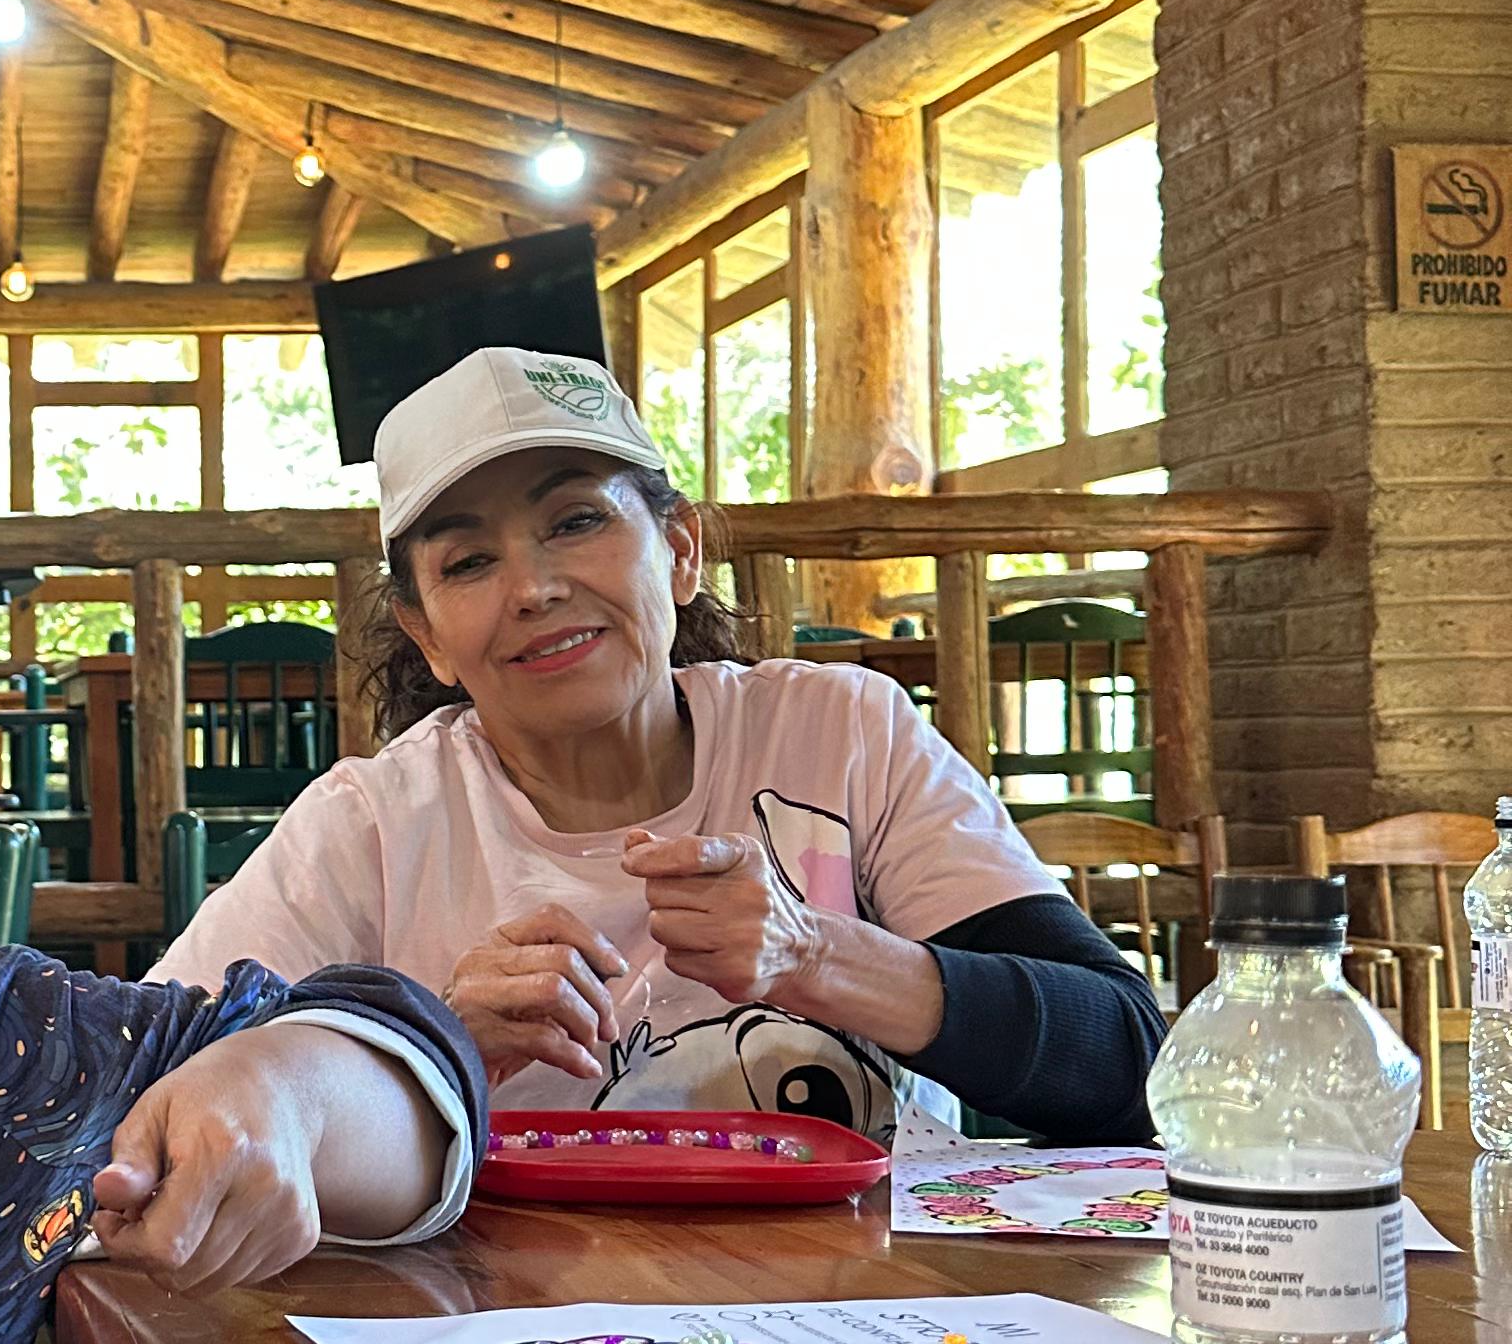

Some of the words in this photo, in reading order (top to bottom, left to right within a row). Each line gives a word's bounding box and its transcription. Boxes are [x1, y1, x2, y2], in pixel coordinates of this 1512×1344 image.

[1411, 252, 1508, 277] PROHIBIDO
[1419, 281, 1502, 306] FUMAR
[1207, 1213, 1245, 1227] TOYOTA
[1247, 1217, 1318, 1231] ACUEDUCTO
[1194, 1223, 1236, 1239] Acueducto
[1246, 1229, 1293, 1243] Periférico
[1195, 1237, 1207, 1248] Tel.
[1209, 1241, 1220, 1251] 33
[1209, 1265, 1247, 1279] TOYOTA
[1249, 1270, 1304, 1284] COUNTRY
[1210, 1293, 1220, 1304] 33
[1306, 1286, 1327, 1297] Plan
[1329, 1286, 1341, 1297] de
[1343, 1284, 1360, 1296] San
[1362, 1283, 1377, 1295] Luis
[975, 1321, 1041, 1338] MI
